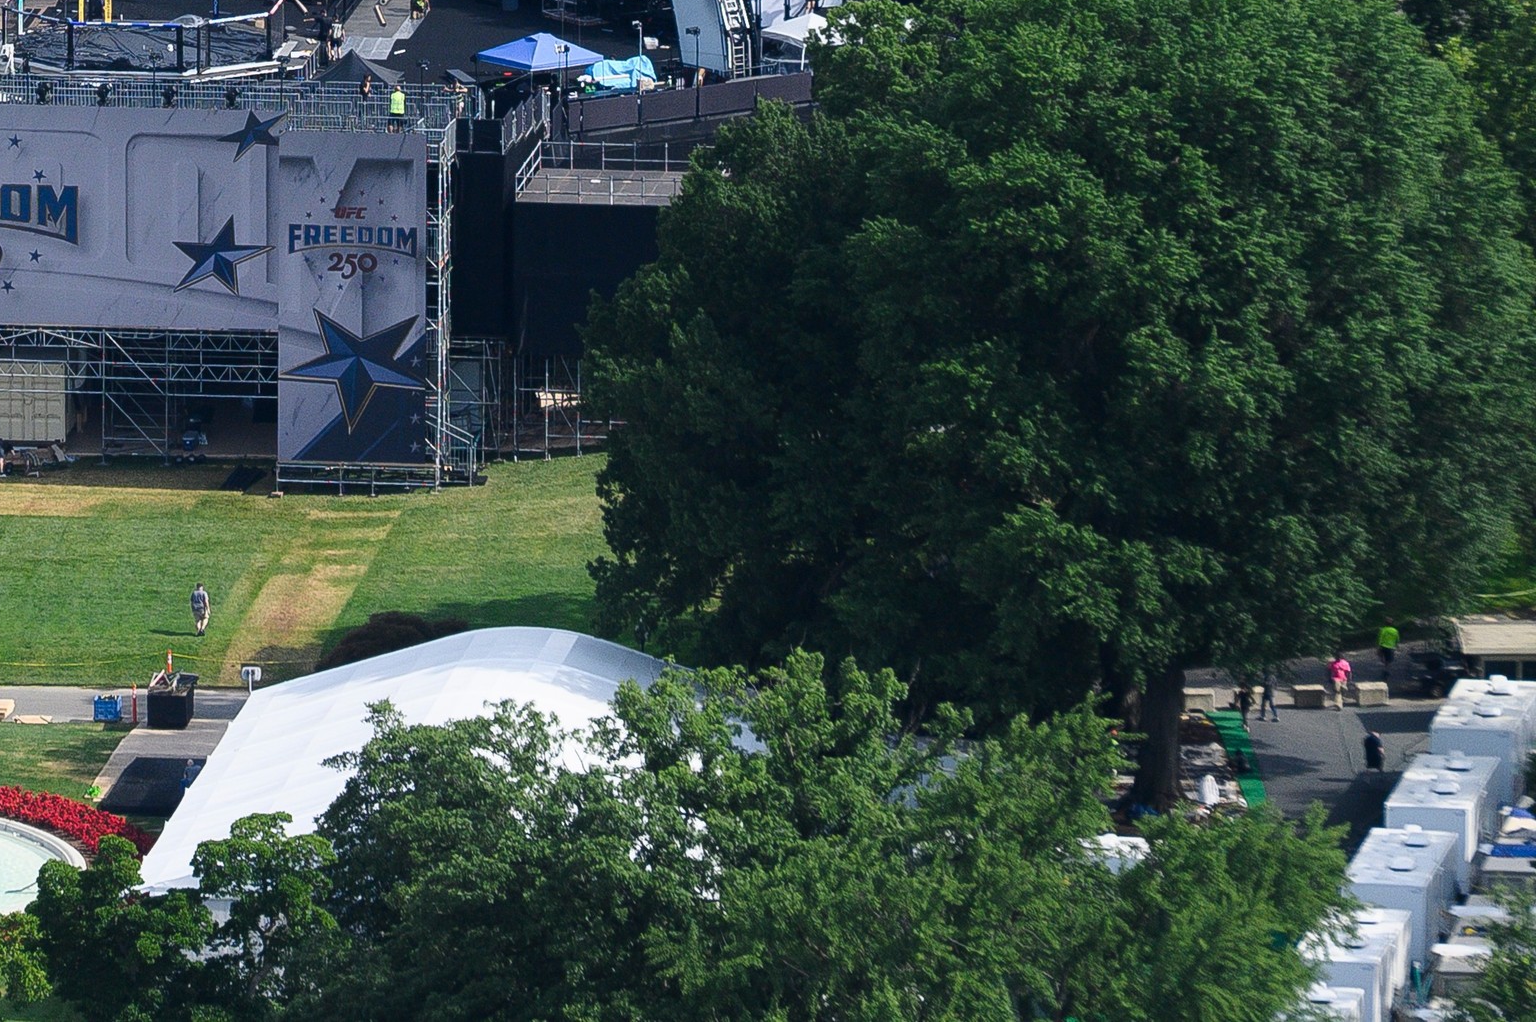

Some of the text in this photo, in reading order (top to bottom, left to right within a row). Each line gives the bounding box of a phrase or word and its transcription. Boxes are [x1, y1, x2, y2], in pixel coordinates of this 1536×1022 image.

[334, 207, 367, 219] UFC
[288, 223, 418, 258] FREEDOM
[327, 253, 378, 280] 250
